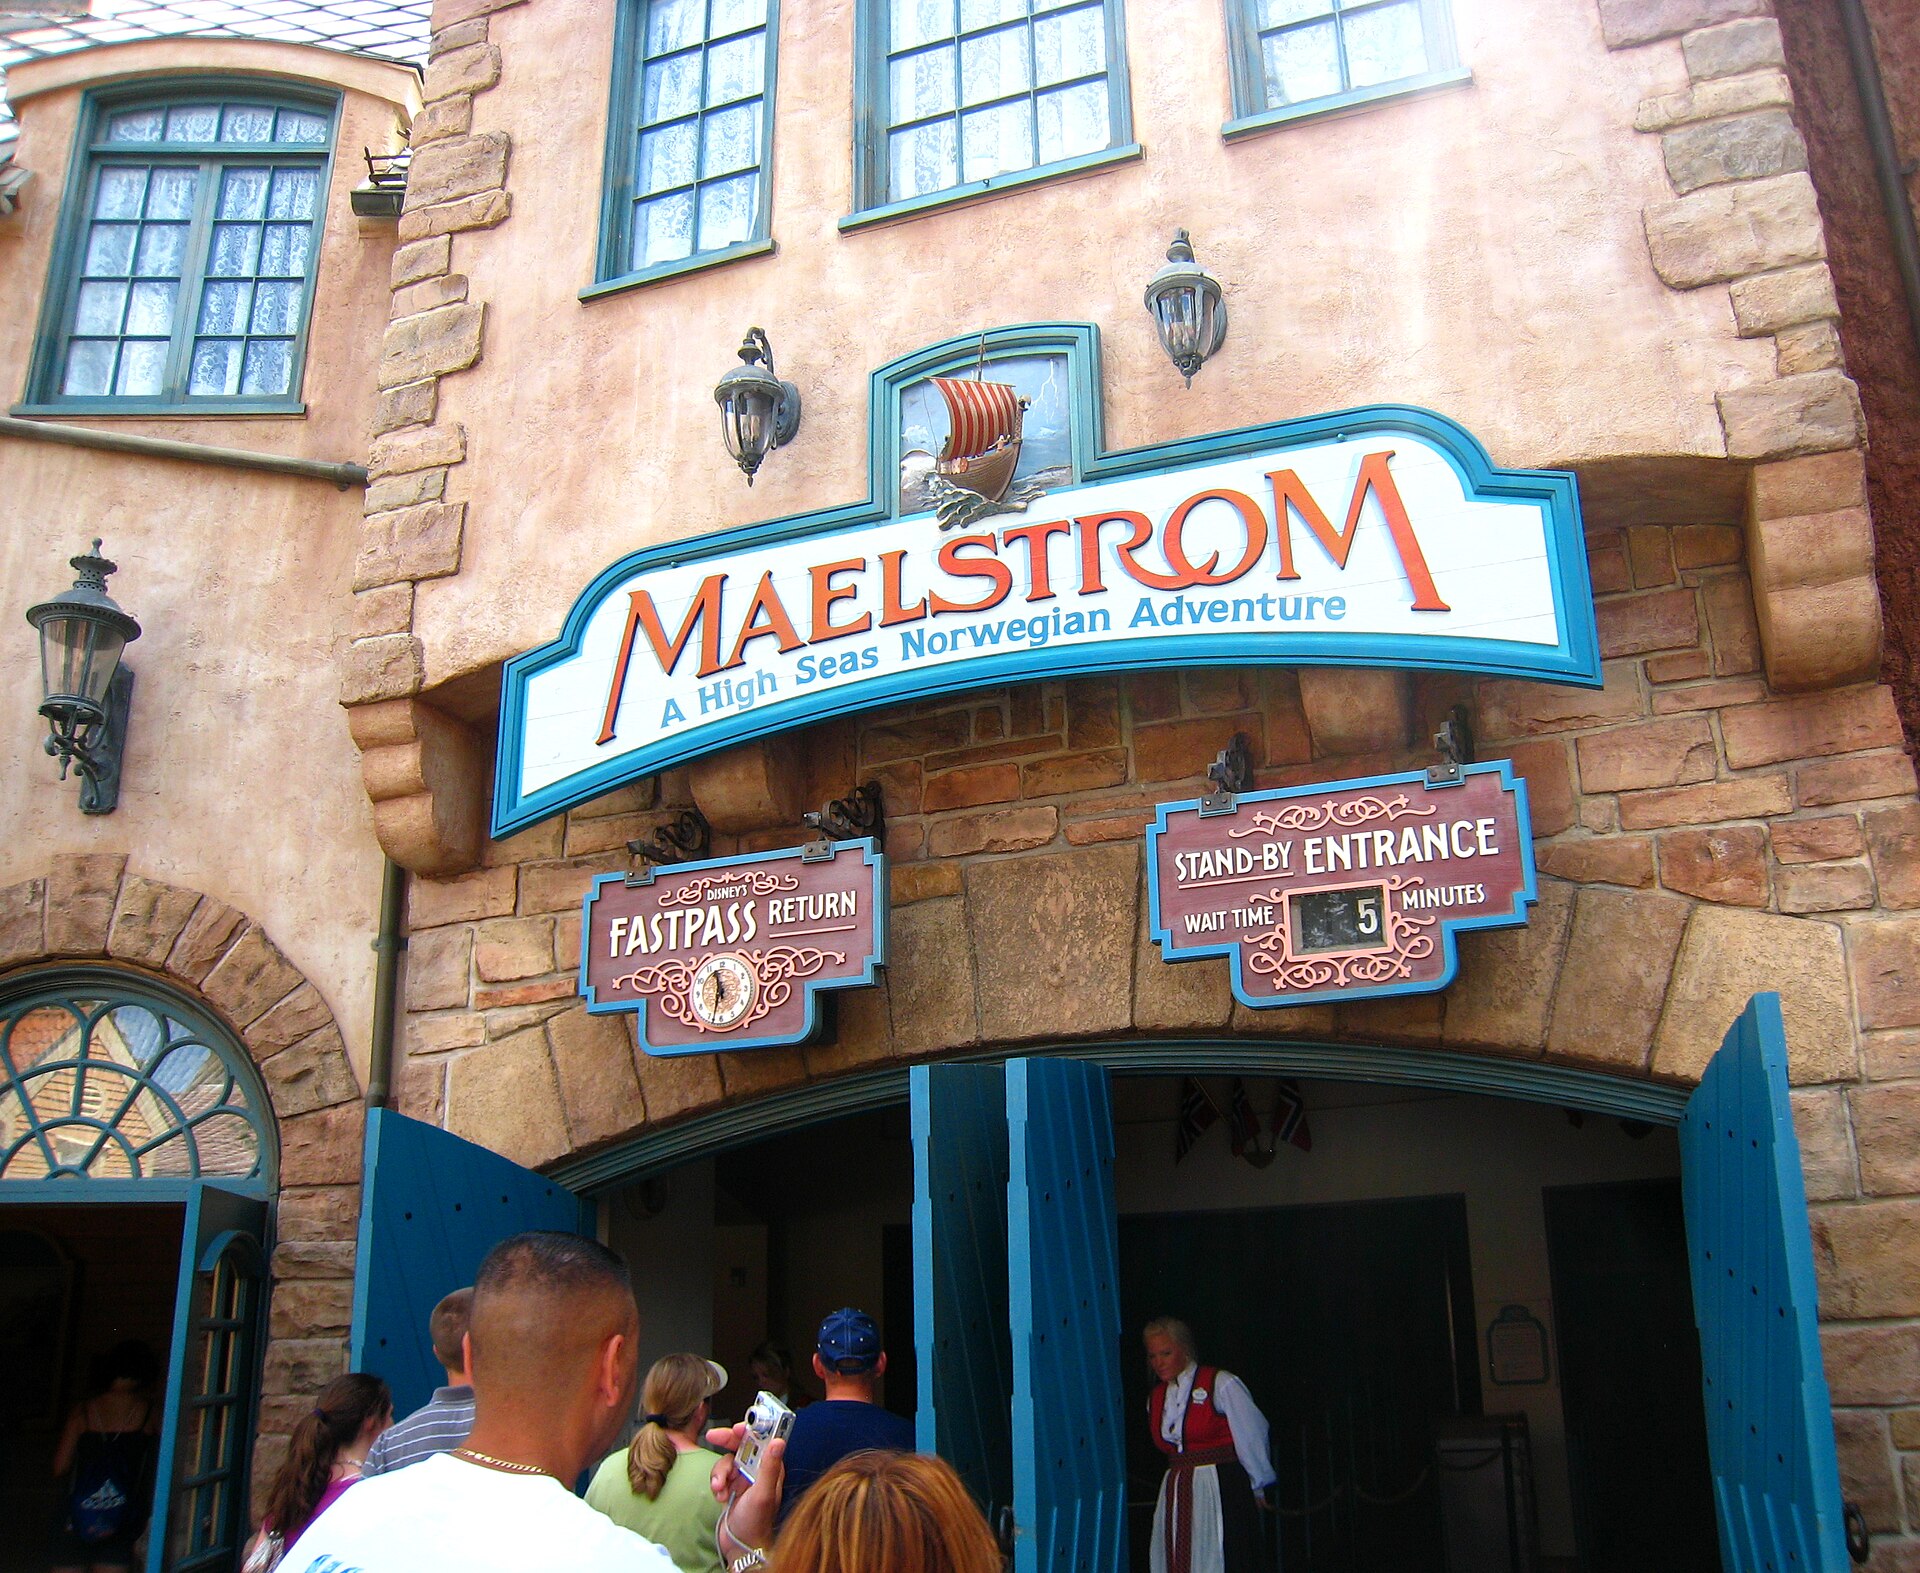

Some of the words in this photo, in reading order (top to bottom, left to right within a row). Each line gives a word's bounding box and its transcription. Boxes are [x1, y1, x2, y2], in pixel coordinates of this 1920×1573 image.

[595, 450, 1451, 746] MAELSTROM
[660, 698, 686, 729] A
[699, 667, 777, 711] High
[796, 645, 879, 685] Seas
[900, 605, 1111, 661] Norwegian
[1128, 591, 1347, 628] Adventure
[1175, 840, 1293, 882] STAND-BY
[1304, 817, 1499, 875] ENTRANCE
[610, 900, 758, 958] FASTPASS
[768, 890, 857, 925] RETURN
[707, 884, 748, 901] DISNEY'S
[1184, 909, 1227, 934] WAIT
[1233, 905, 1275, 929] TIME
[1357, 898, 1379, 935] 5
[1402, 883, 1486, 911] MINUTES
